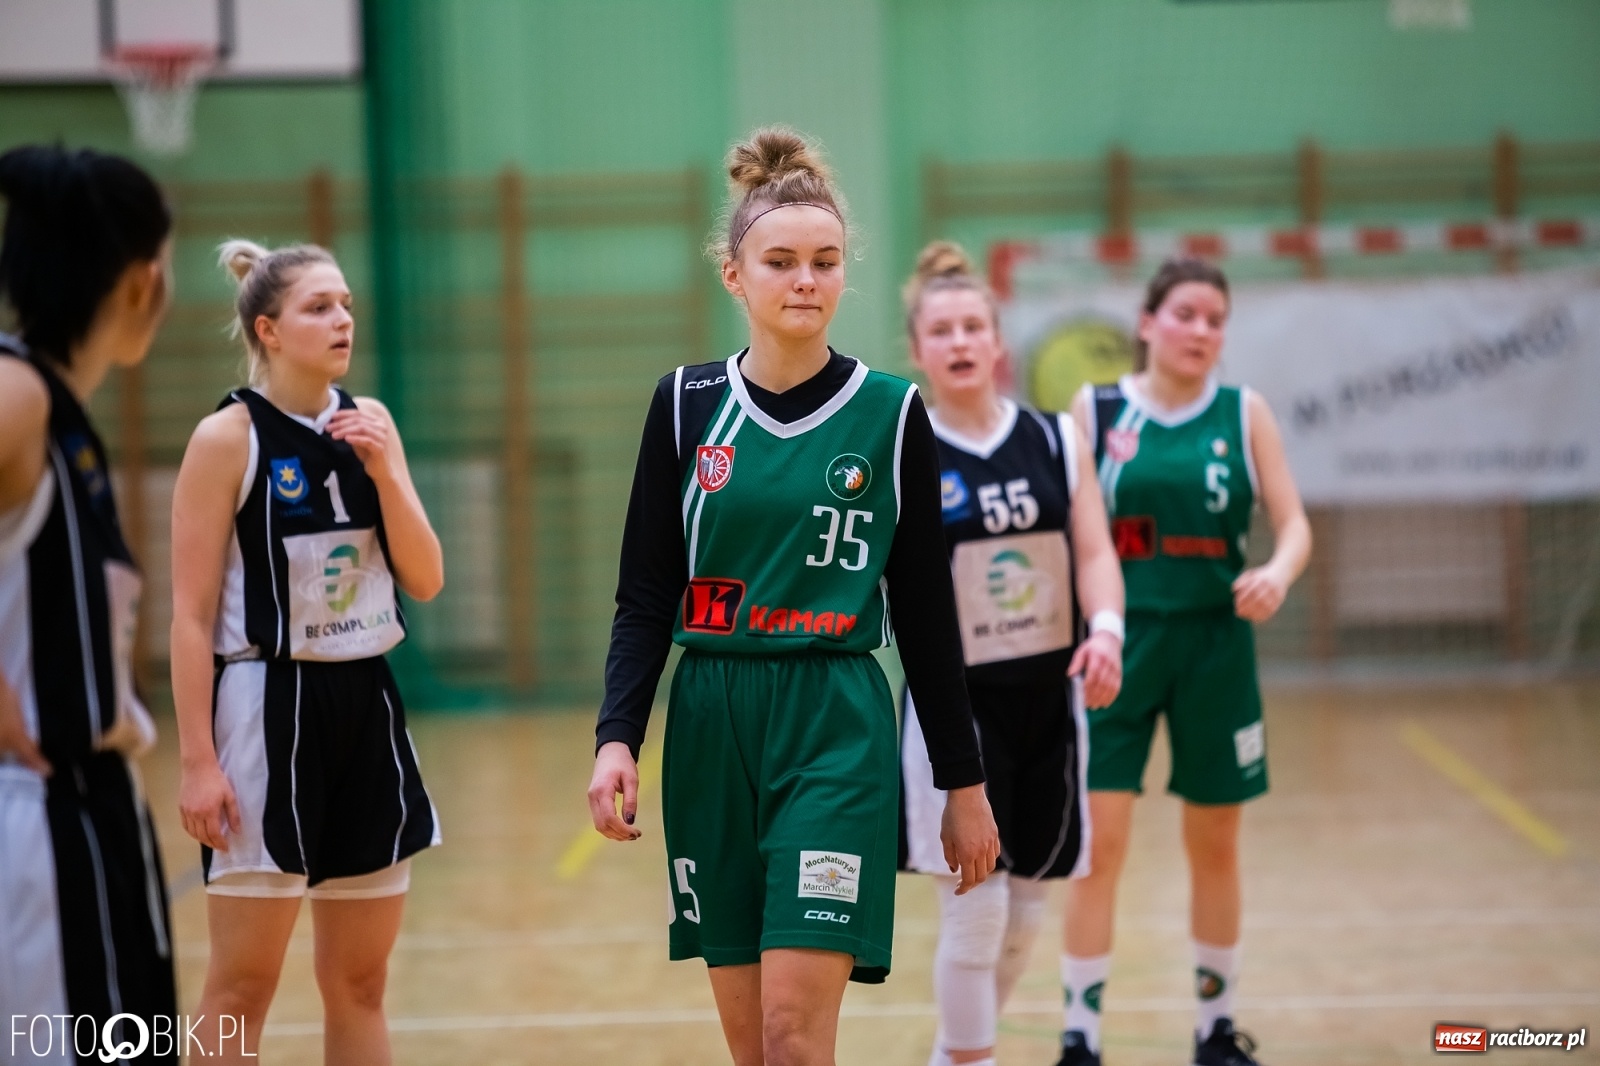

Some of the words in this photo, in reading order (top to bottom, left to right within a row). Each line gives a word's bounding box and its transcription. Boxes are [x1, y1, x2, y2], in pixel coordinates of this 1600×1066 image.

[685, 376, 727, 390] COLO
[323, 470, 350, 523] 1
[977, 477, 1040, 534] 55
[1206, 463, 1230, 513] 5
[805, 505, 873, 571] 35
[688, 585, 735, 627] K
[748, 605, 858, 636] KAMAN
[305, 623, 320, 639] BE
[805, 855, 857, 875] MoceNatury.pl
[803, 883, 830, 892] Marcin
[832, 885, 854, 895] Nykiel
